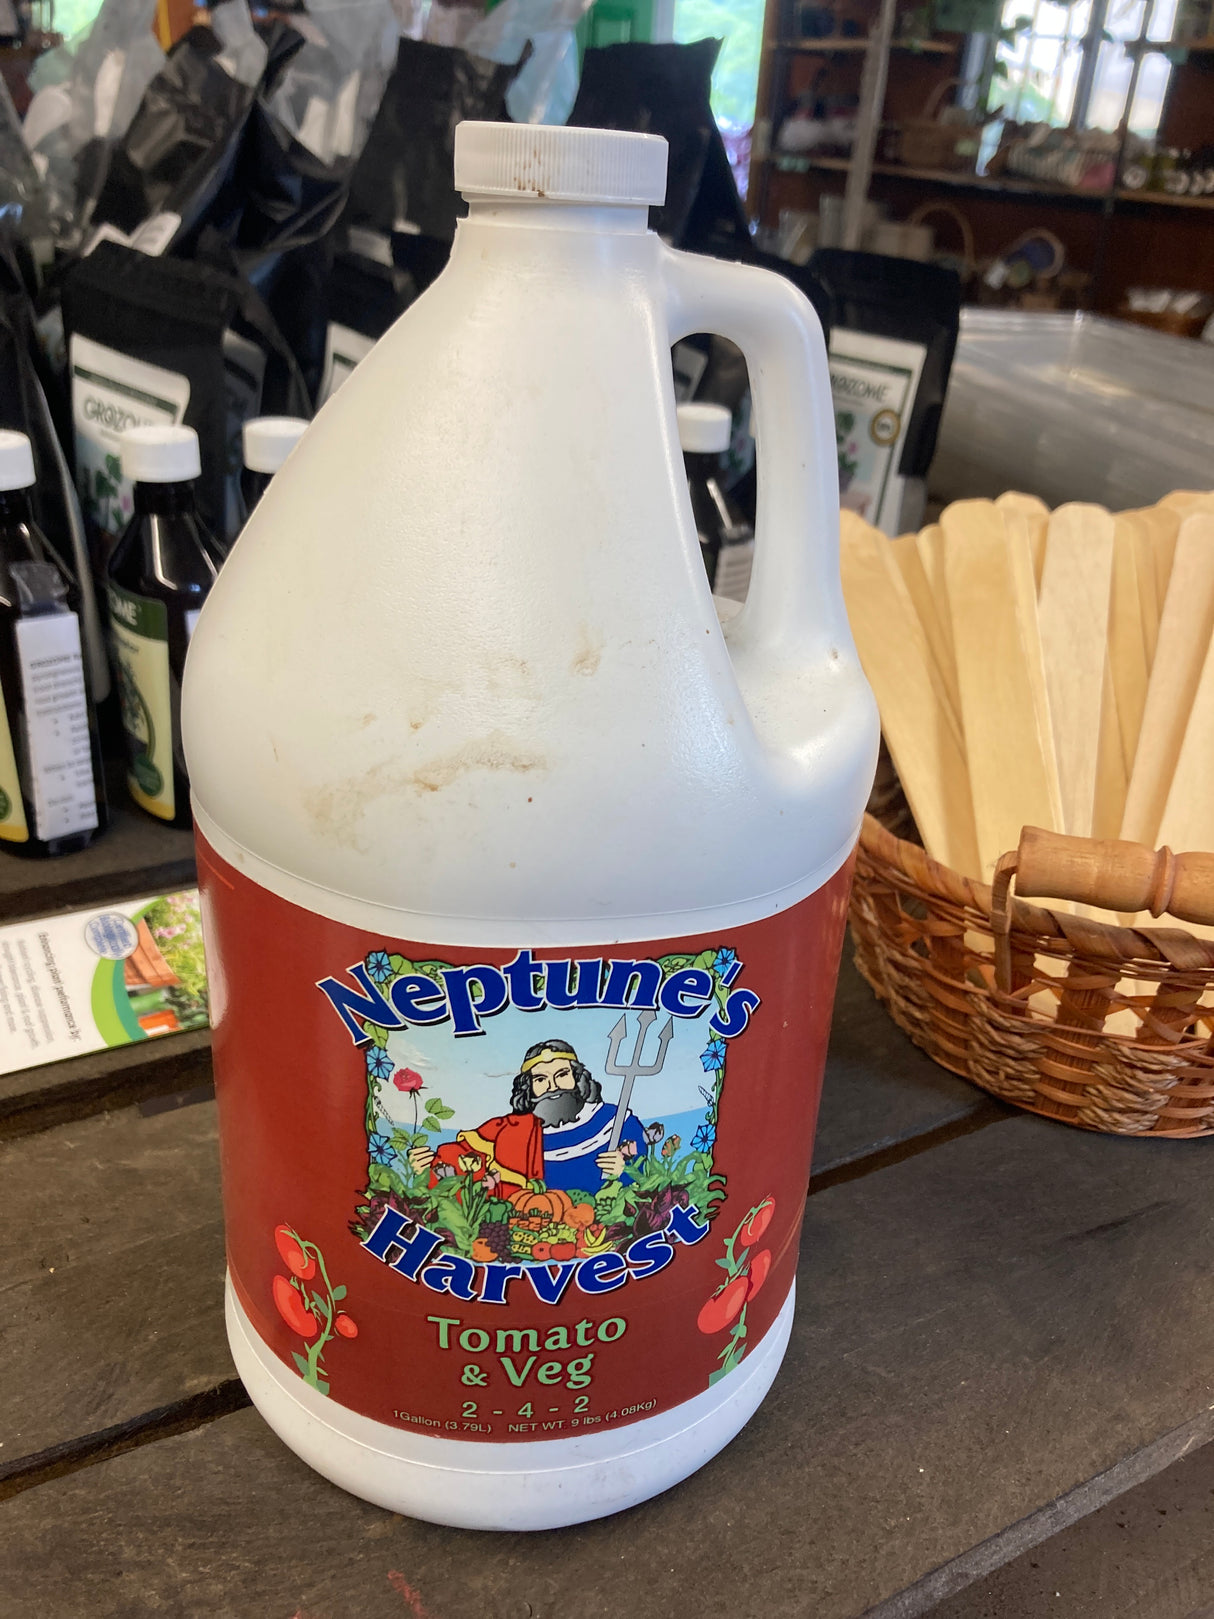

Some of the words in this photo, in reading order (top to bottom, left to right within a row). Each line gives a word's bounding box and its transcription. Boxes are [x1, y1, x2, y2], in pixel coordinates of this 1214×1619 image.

[316, 949, 760, 1048] Neptune's
[360, 1202, 710, 1306] Harvest
[427, 1315, 627, 1353] Tomato
[460, 1364, 488, 1387] &
[500, 1353, 595, 1390] Veg
[393, 1409, 441, 1428] 1Gallon
[444, 1421, 492, 1434] (3.79L)
[508, 1423, 537, 1433] NET
[571, 1418, 580, 1428] 9
[583, 1414, 602, 1426] lbs
[605, 1398, 657, 1422] (4.08Kg)
[461, 1401, 478, 1419] 2
[517, 1401, 534, 1419] 4
[573, 1395, 590, 1414] 2
